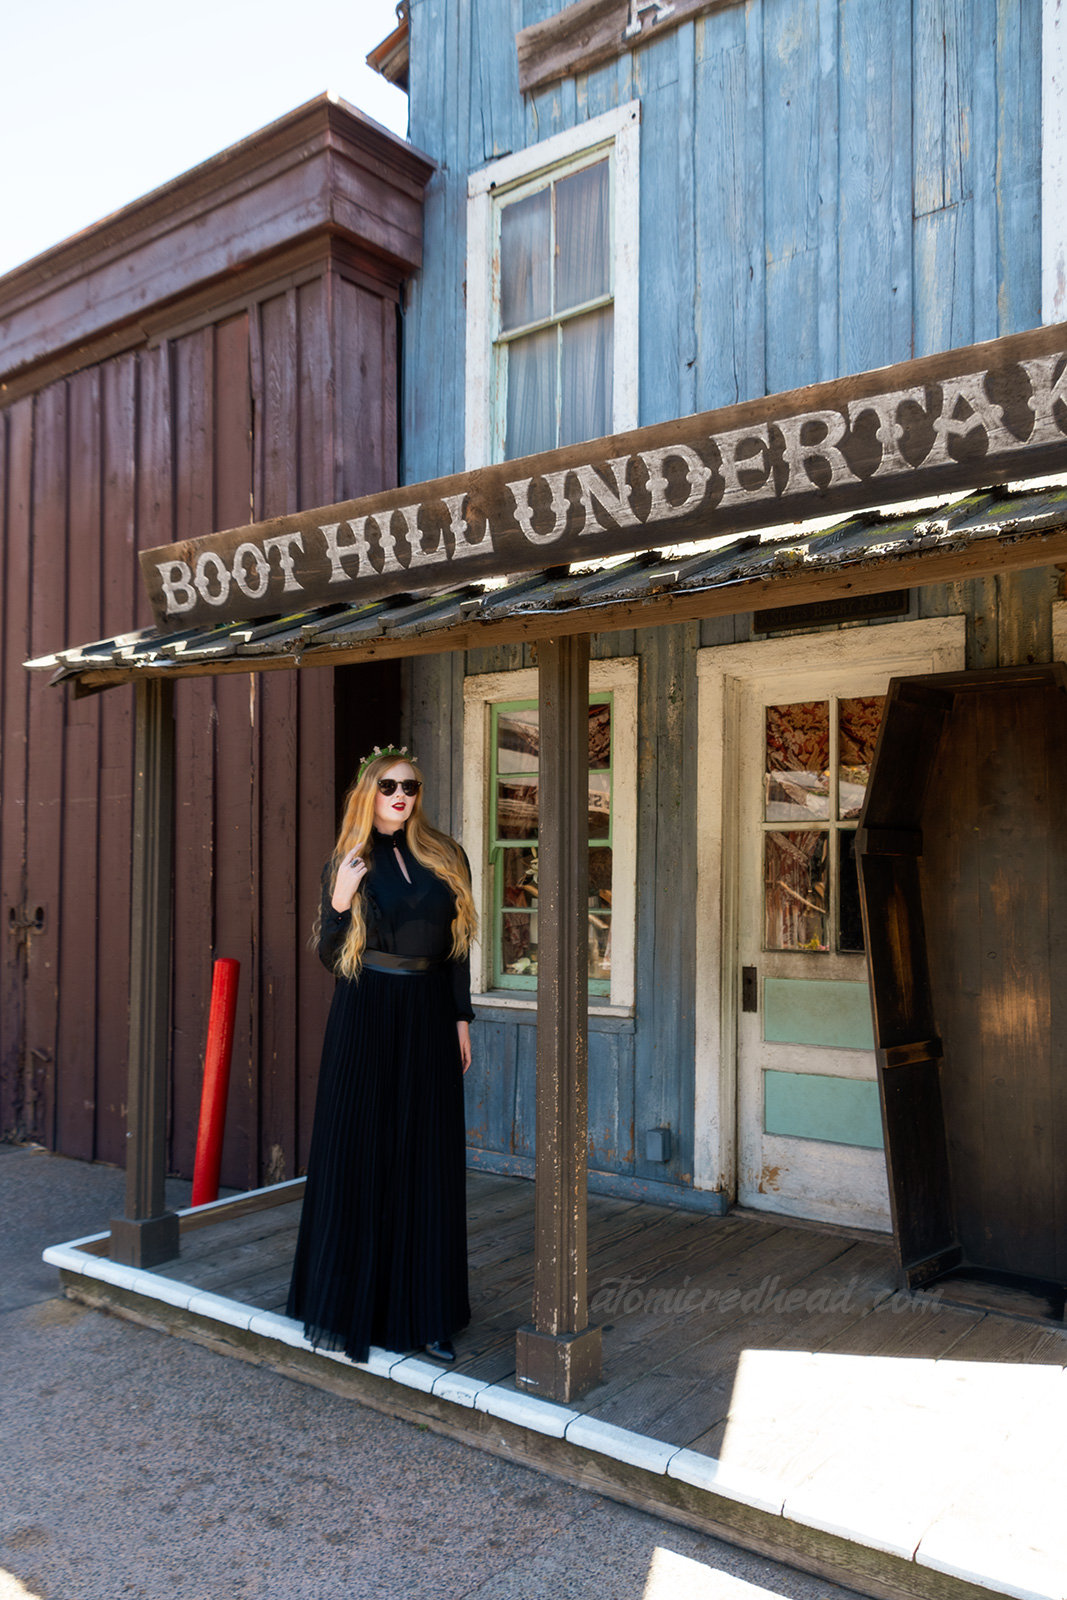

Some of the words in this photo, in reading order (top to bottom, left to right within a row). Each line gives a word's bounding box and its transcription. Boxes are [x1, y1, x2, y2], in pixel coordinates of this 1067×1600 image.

[155, 532, 304, 615] BOOT
[318, 493, 494, 583] HILL
[813, 601, 855, 618] BERRY
[858, 595, 900, 612] FARM
